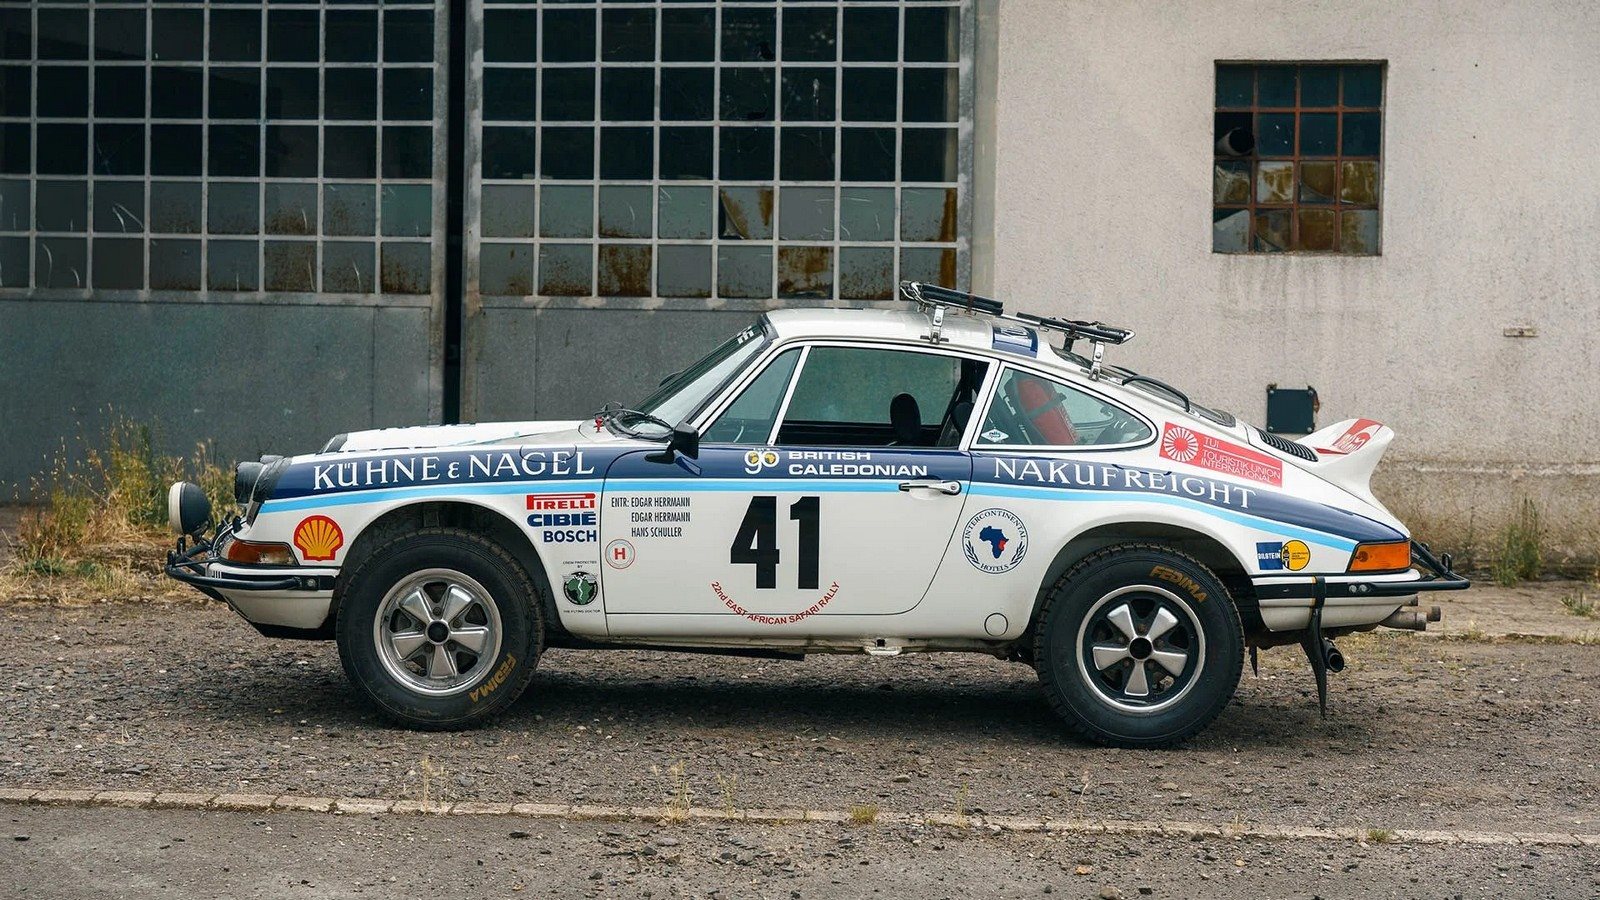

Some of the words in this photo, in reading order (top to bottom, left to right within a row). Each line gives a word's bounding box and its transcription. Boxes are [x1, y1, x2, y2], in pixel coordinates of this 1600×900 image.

[1204, 437, 1219, 448] TUI
[788, 451, 871, 460] BRITISH
[313, 456, 441, 490] KÜHNE
[469, 451, 595, 478] NAGEL
[788, 465, 927, 476] CALEDONIAN
[1200, 458, 1271, 481] INTERNATIONAL
[1202, 450, 1249, 471] TOURISTIK
[1250, 464, 1280, 479] UNION
[994, 457, 1256, 508] NAKUFREIGHT
[527, 493, 596, 510] PIRELLI
[611, 497, 629, 507] ENTR:
[631, 497, 653, 507] EDGAR
[654, 497, 691, 507] HERRMANN
[631, 512, 653, 522] EDGAR
[654, 511, 691, 522] HERRMANN
[631, 527, 649, 537] HANS
[650, 527, 682, 537] SCHULLER
[965, 511, 1026, 539] INTERCONTINENTAL
[543, 530, 597, 543] BOSCH
[731, 496, 820, 589] 41
[614, 547, 625, 560] H
[1258, 552, 1281, 560] BILSTEIN
[980, 563, 1009, 571] HOTELS
[1149, 565, 1207, 602] FEDIMA
[711, 581, 728, 601] 22nd
[725, 599, 748, 616] EAST
[747, 613, 787, 625] AFRICAN
[789, 604, 820, 623] SAFARI
[818, 581, 840, 608] RALLY
[469, 652, 516, 704] FEDIMA
